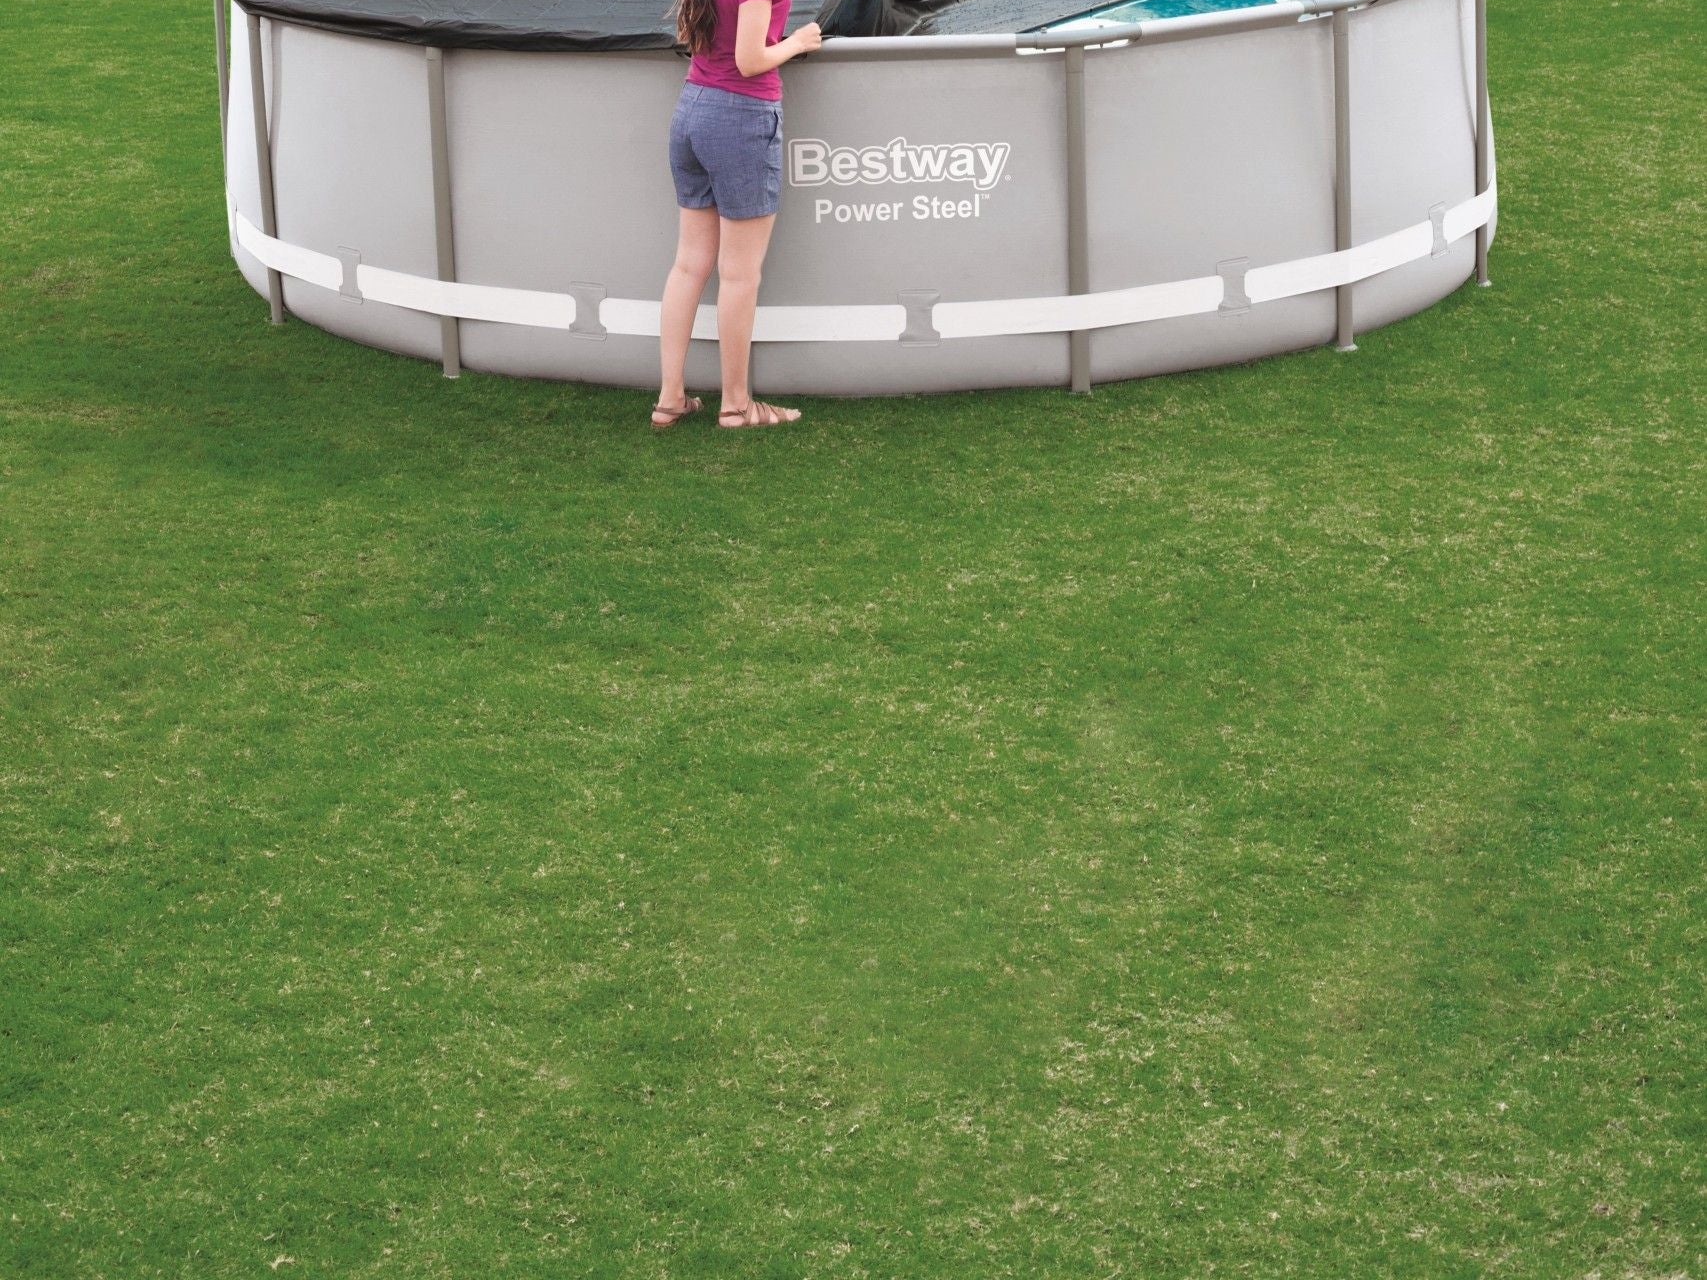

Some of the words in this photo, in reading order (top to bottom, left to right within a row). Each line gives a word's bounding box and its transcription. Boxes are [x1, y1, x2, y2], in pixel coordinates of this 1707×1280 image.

[790, 138, 1010, 189] Bestway
[815, 199, 903, 223] Power
[912, 193, 980, 220] Steel
